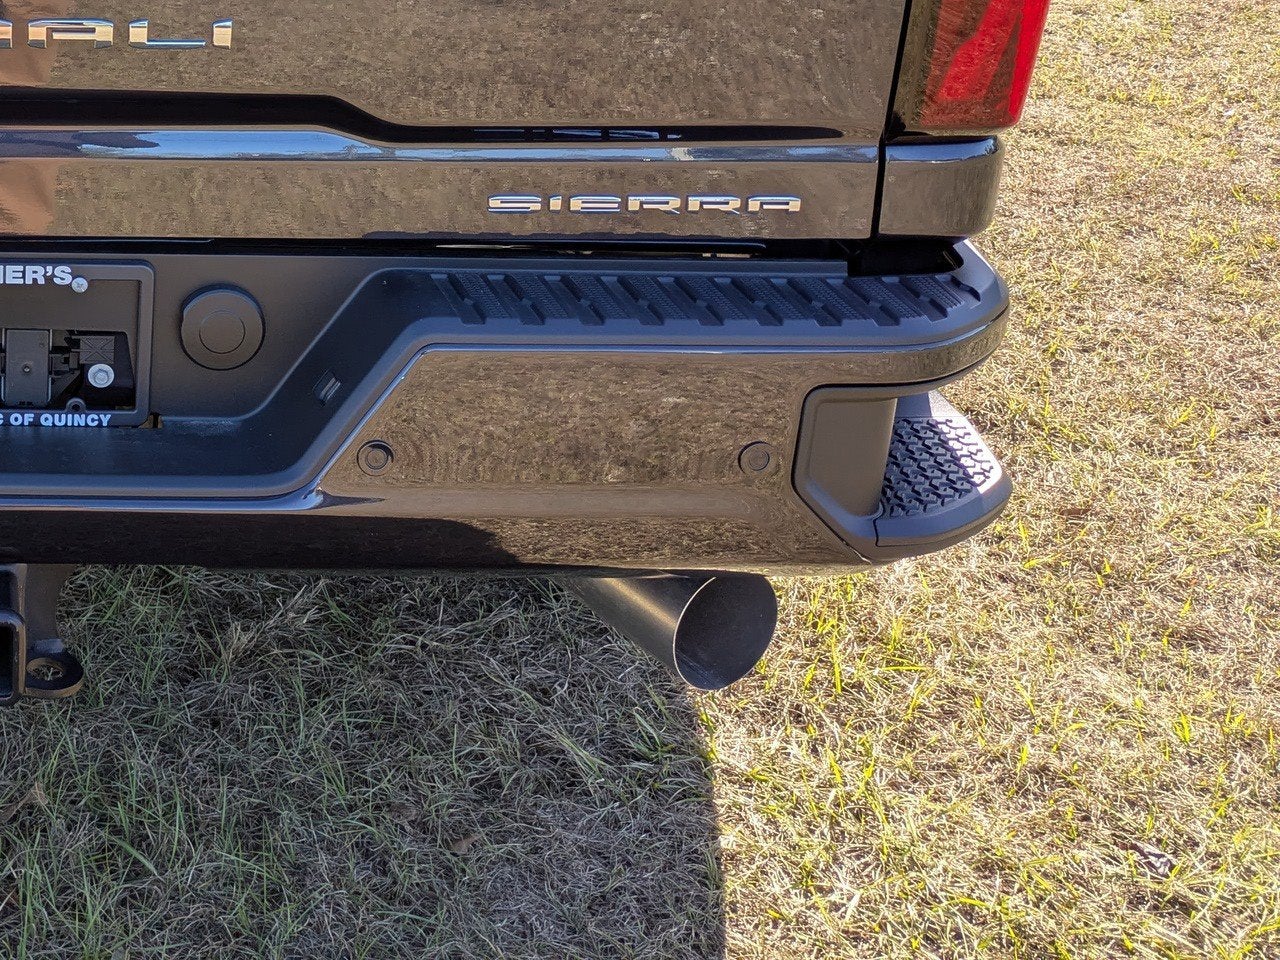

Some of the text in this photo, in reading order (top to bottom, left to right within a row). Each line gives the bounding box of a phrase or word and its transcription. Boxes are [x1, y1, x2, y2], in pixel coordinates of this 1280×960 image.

[488, 194, 802, 215] SIERRA
[10, 413, 35, 427] OF
[39, 413, 112, 428] QUINCY
